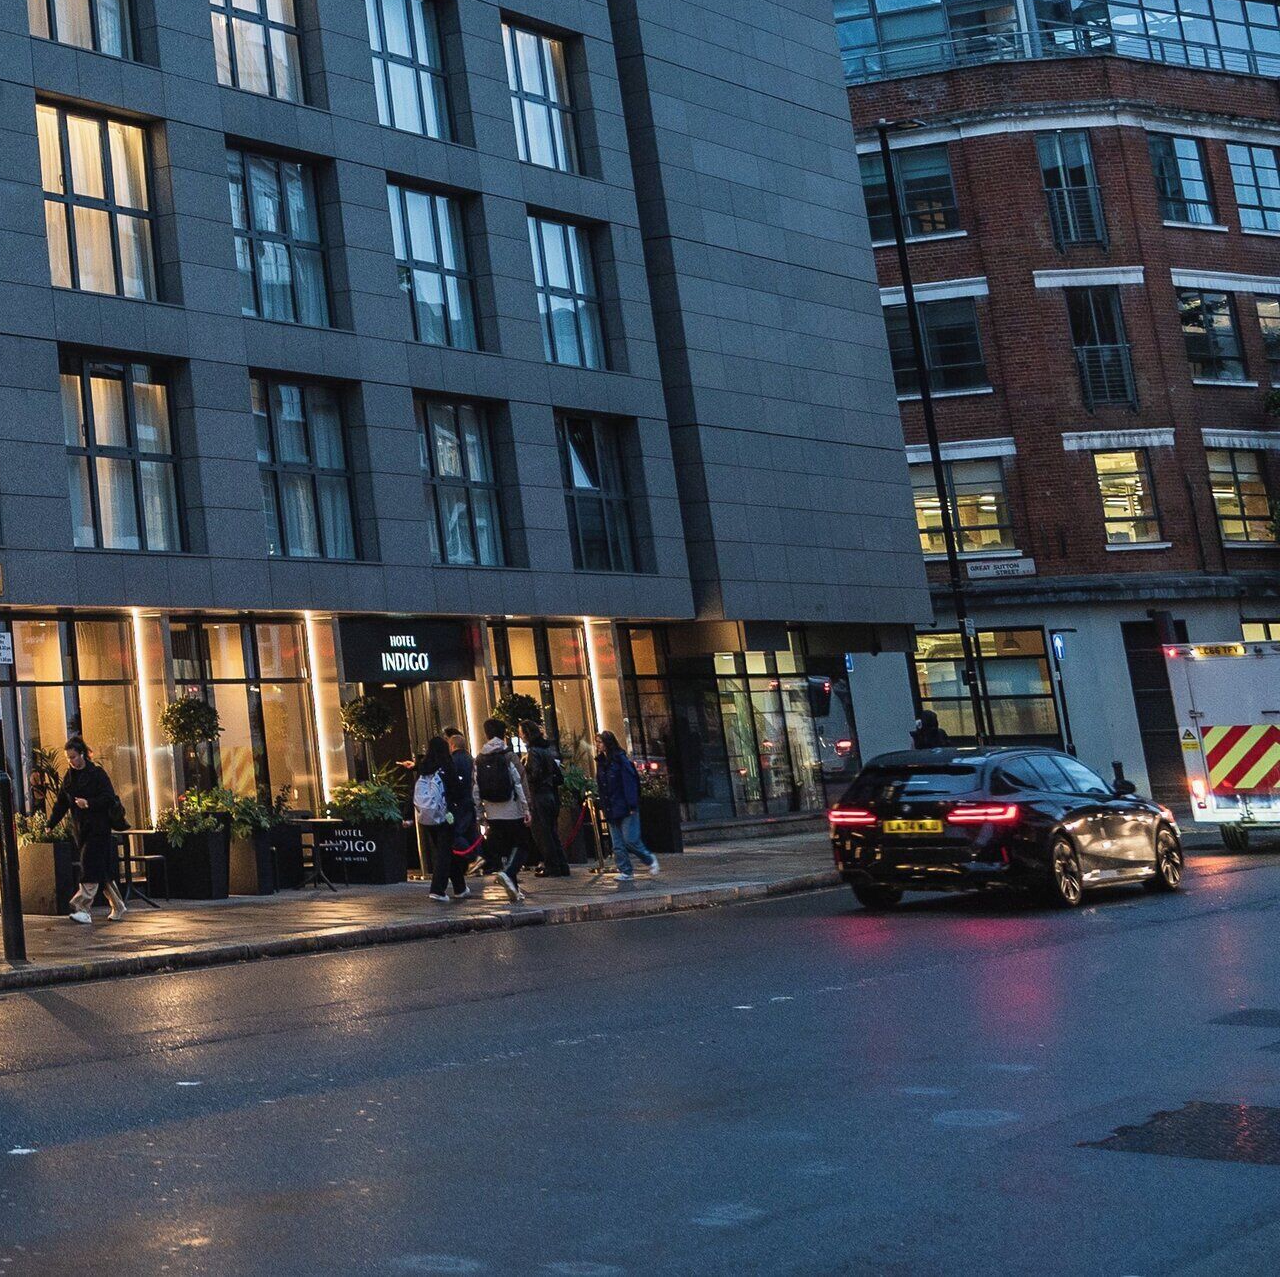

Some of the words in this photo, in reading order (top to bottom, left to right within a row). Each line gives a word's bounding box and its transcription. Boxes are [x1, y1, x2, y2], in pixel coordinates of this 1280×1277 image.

[969, 564, 990, 572] GREAT
[993, 562, 1020, 570] SUTTON
[389, 635, 417, 647] HOTEL
[381, 652, 429, 672] INDIGO
[334, 829, 364, 837] HOTEL
